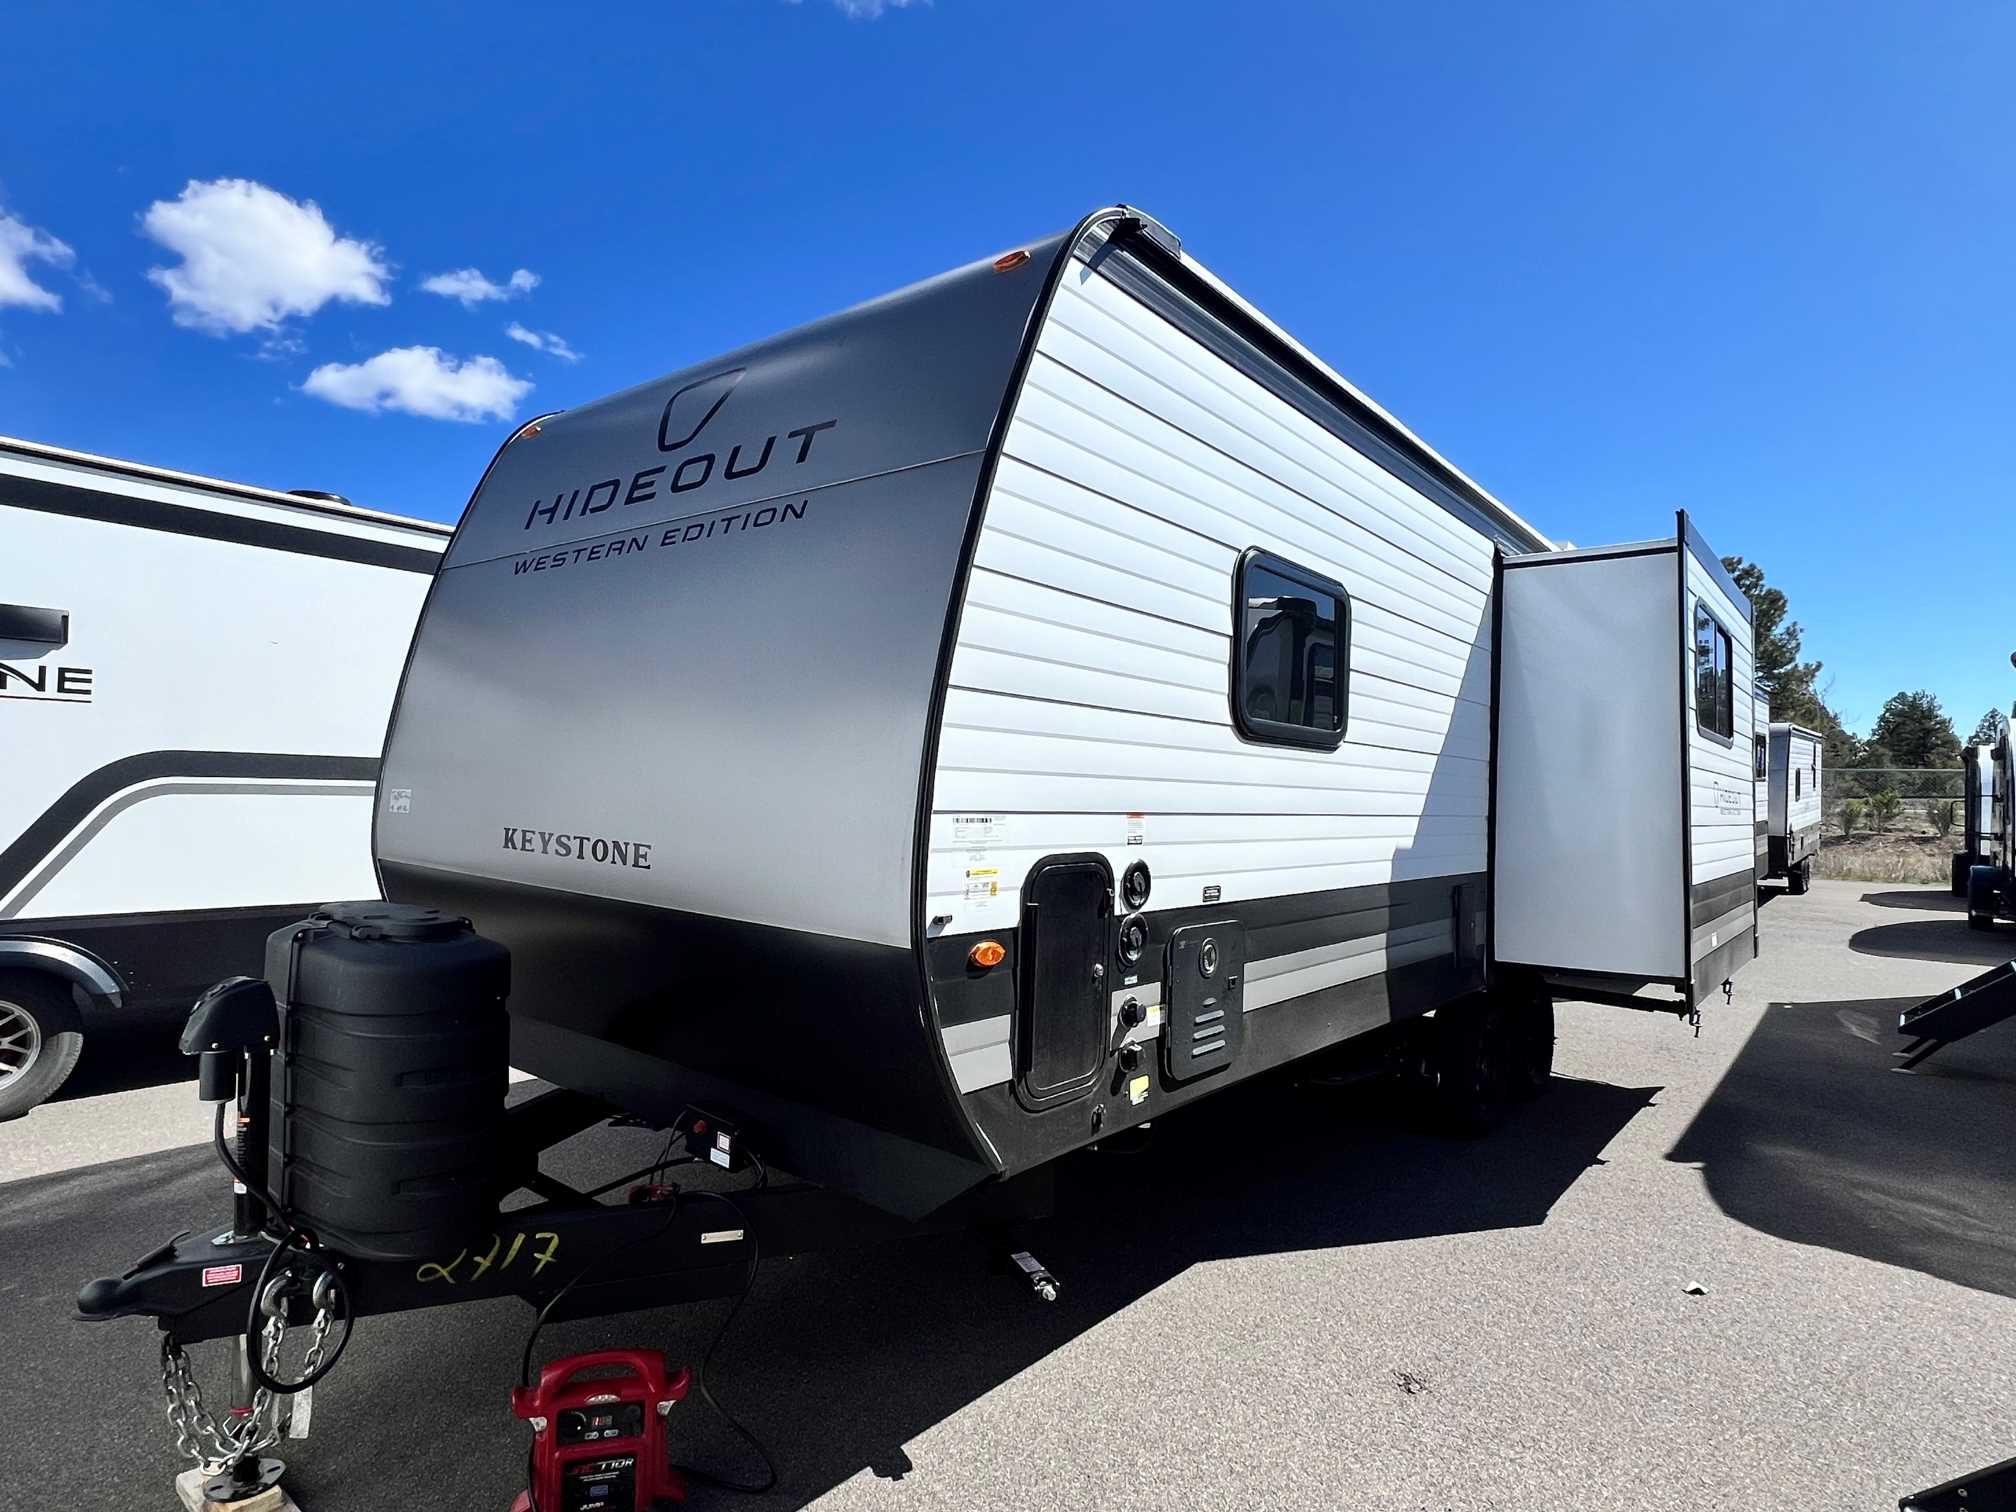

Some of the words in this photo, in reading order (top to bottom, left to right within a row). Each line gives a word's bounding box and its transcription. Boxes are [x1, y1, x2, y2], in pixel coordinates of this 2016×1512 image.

[524, 419, 838, 530] HIDEOUT
[513, 534, 649, 576] WESTERN
[660, 499, 809, 547] EDITION
[502, 827, 652, 870] KEYSTONE
